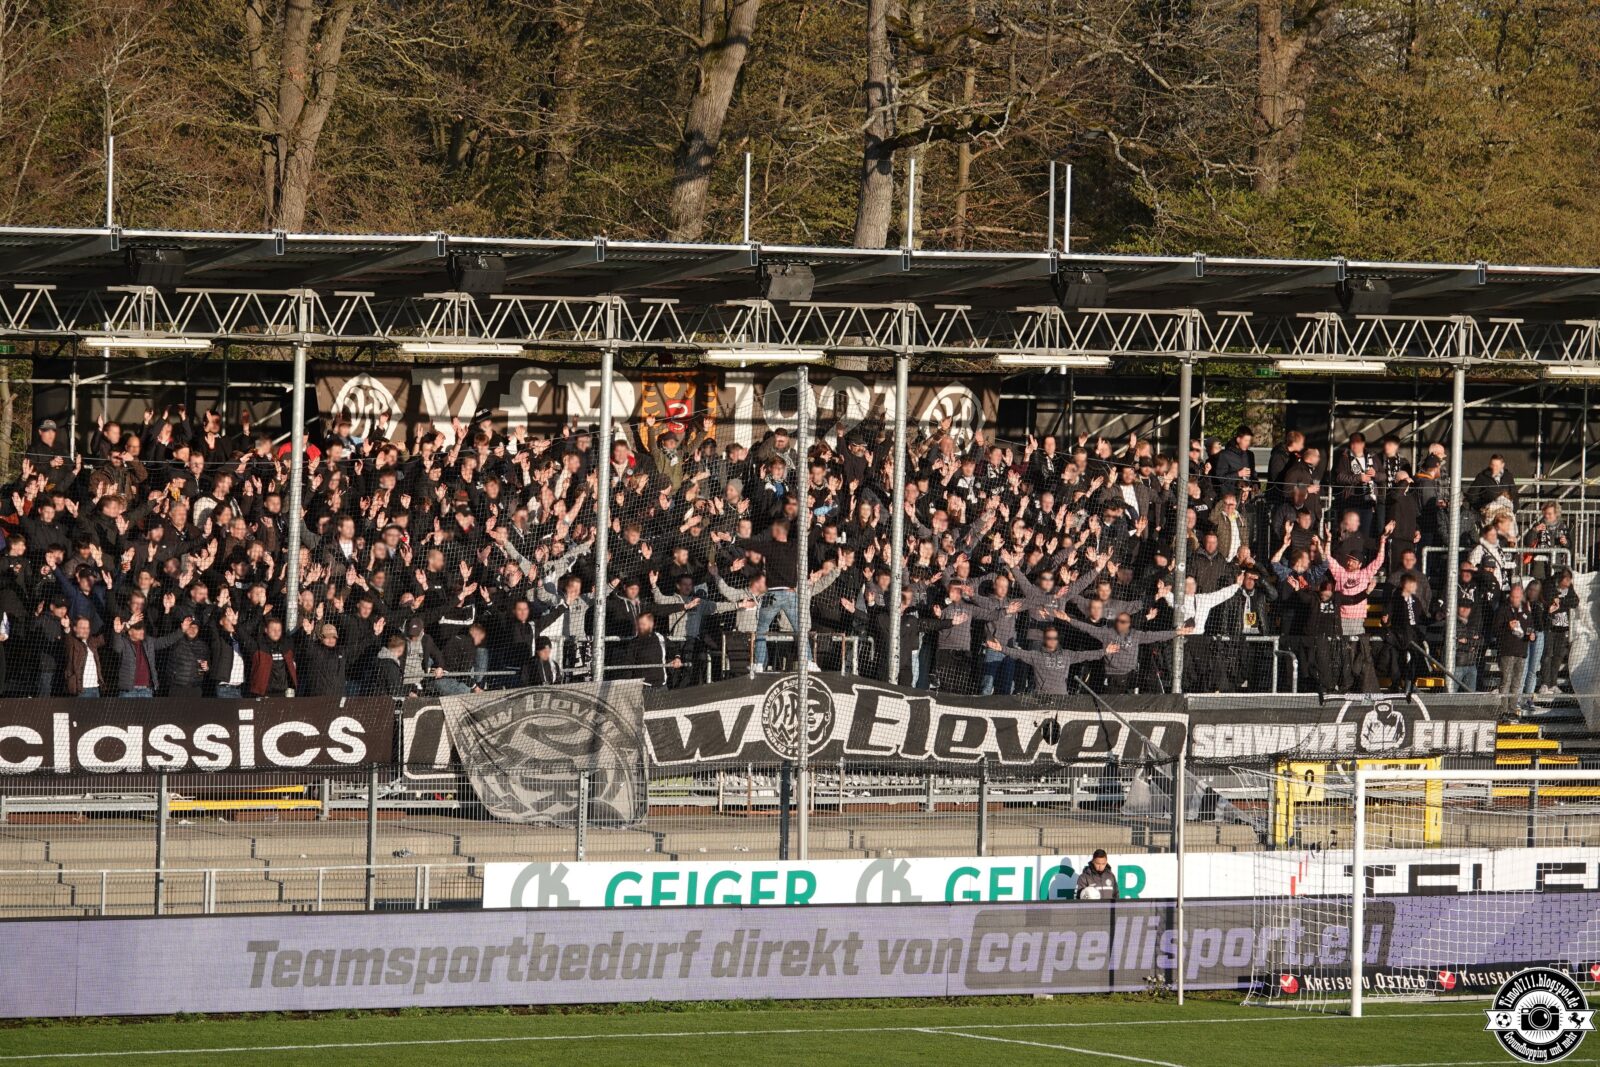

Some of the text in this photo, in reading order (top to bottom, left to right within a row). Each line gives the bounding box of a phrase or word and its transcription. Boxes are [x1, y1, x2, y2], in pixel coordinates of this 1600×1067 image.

[411, 362, 637, 452] VfR
[0, 709, 367, 773] classics
[843, 684, 1190, 769] Eleven
[604, 869, 818, 908] GEIGER
[944, 864, 1147, 901] GEIGR
[246, 915, 1383, 995] Teamsportbedarf direkt von capellisport.eu
[1303, 974, 1370, 991] KREISBU
